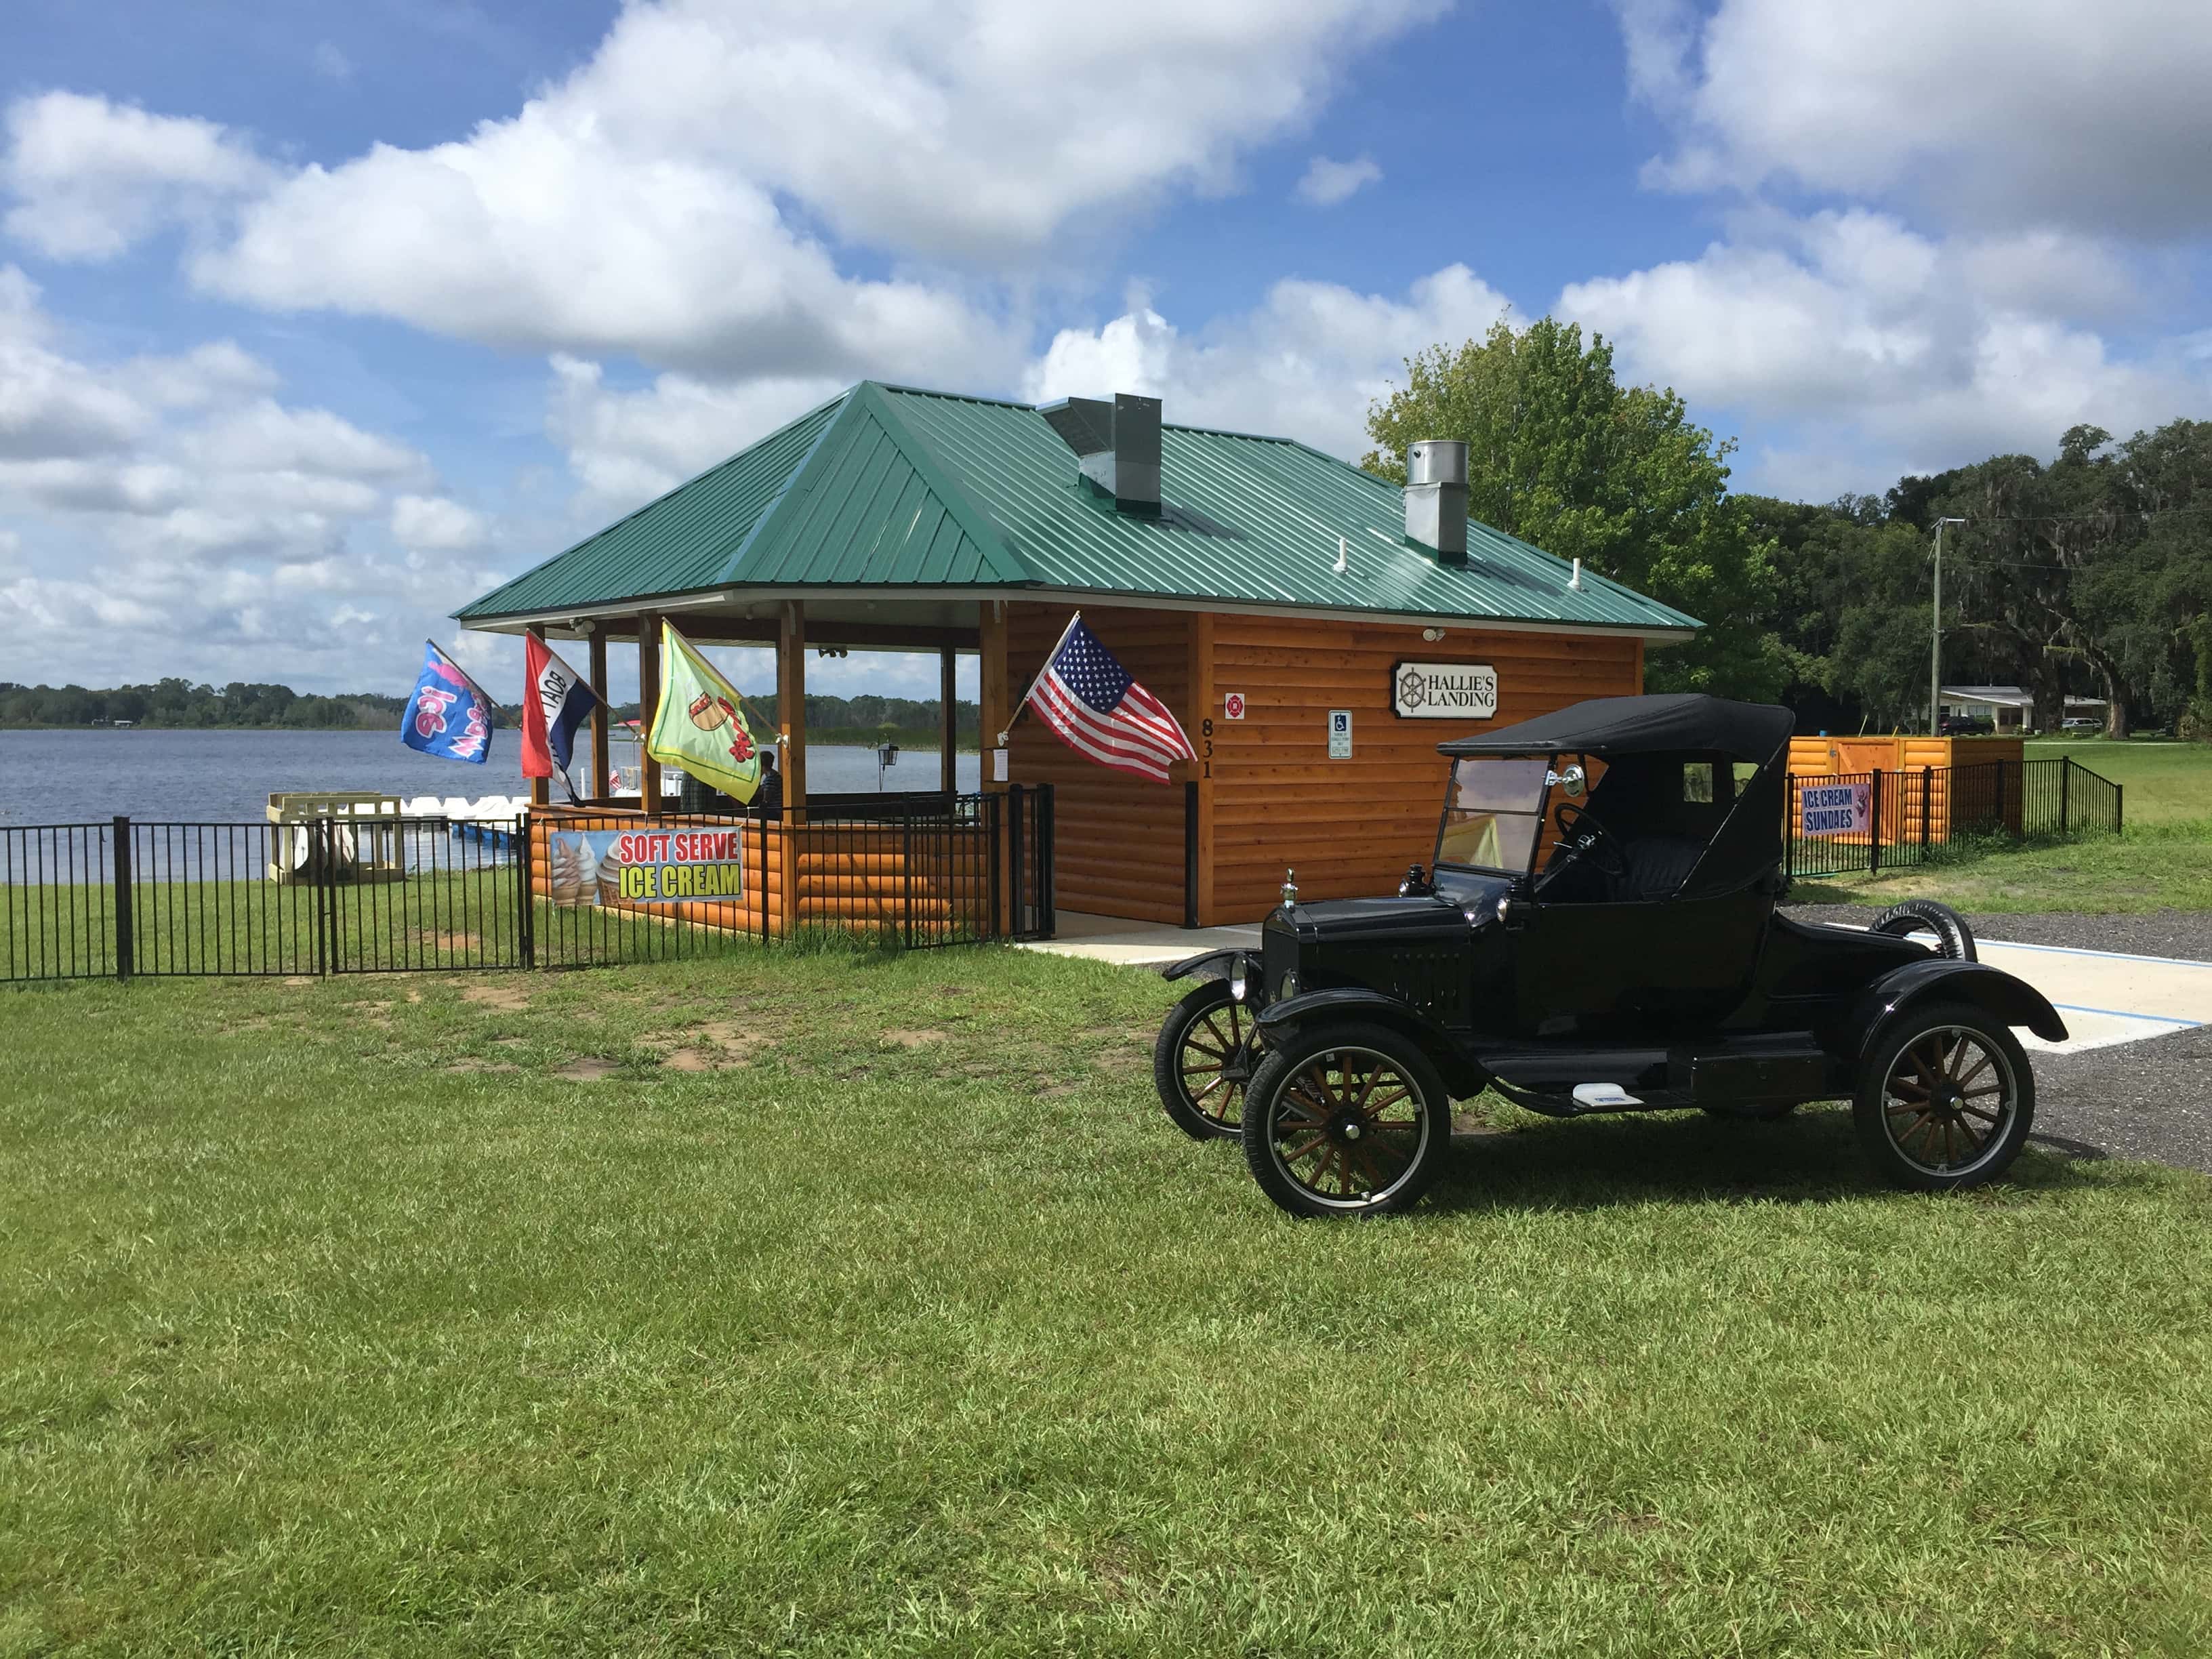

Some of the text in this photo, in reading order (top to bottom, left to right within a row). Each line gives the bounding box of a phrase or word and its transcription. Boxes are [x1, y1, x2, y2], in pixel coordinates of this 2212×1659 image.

[1428, 675, 1494, 692] HALLIE'S
[1427, 691, 1494, 708] LANDING
[1803, 788, 1853, 808] ICE CREAM
[1805, 808, 1853, 832] SUNDAES
[619, 832, 739, 864] SOFT SERVE
[619, 863, 741, 899] ICE CREAM
